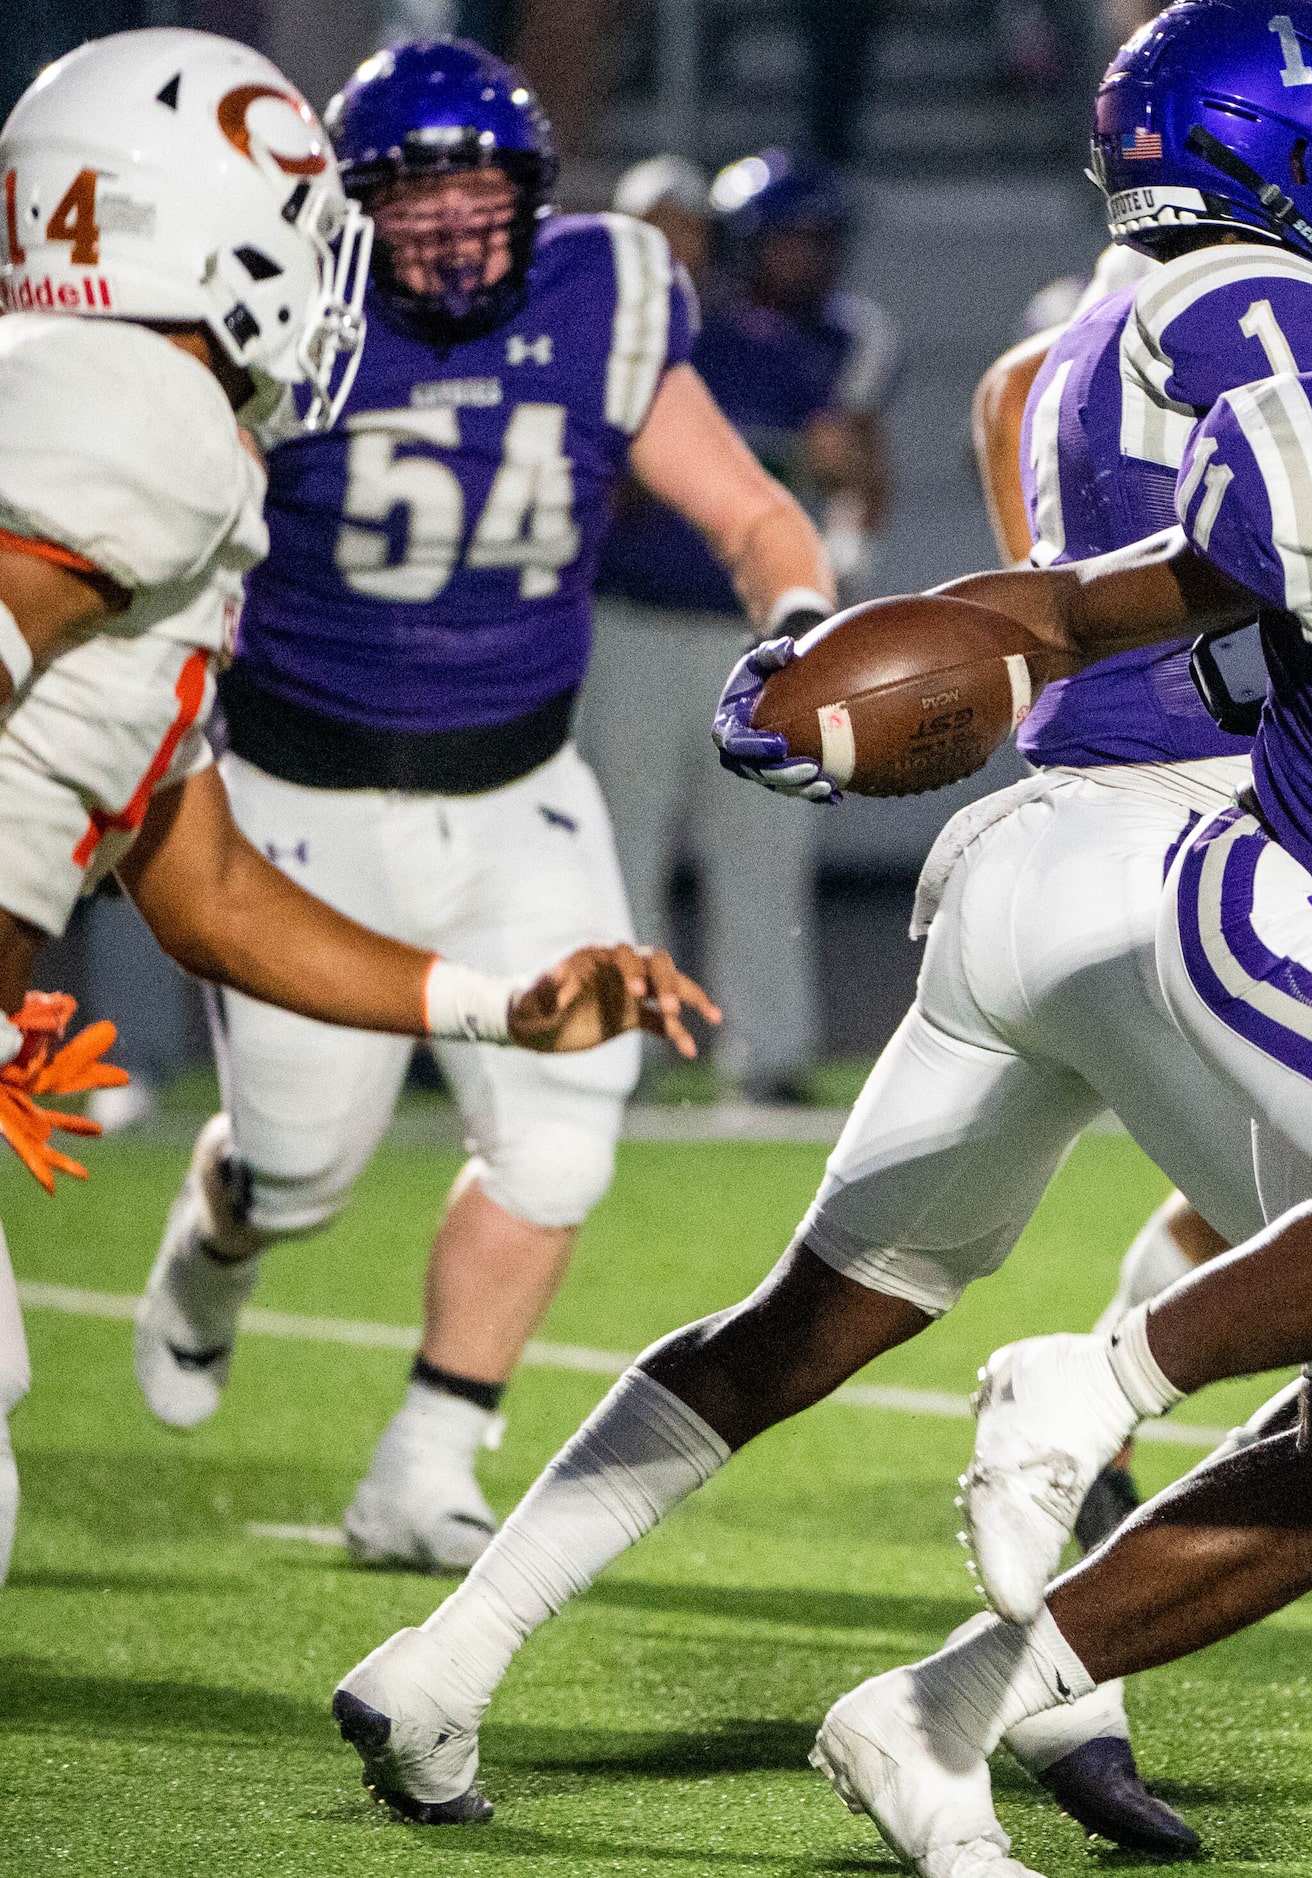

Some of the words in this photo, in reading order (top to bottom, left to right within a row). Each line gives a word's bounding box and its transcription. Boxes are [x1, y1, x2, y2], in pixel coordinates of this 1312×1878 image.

[1143, 189, 1155, 208] U
[1238, 299, 1299, 374] 1
[334, 402, 581, 604] 54
[1177, 437, 1235, 552] 11
